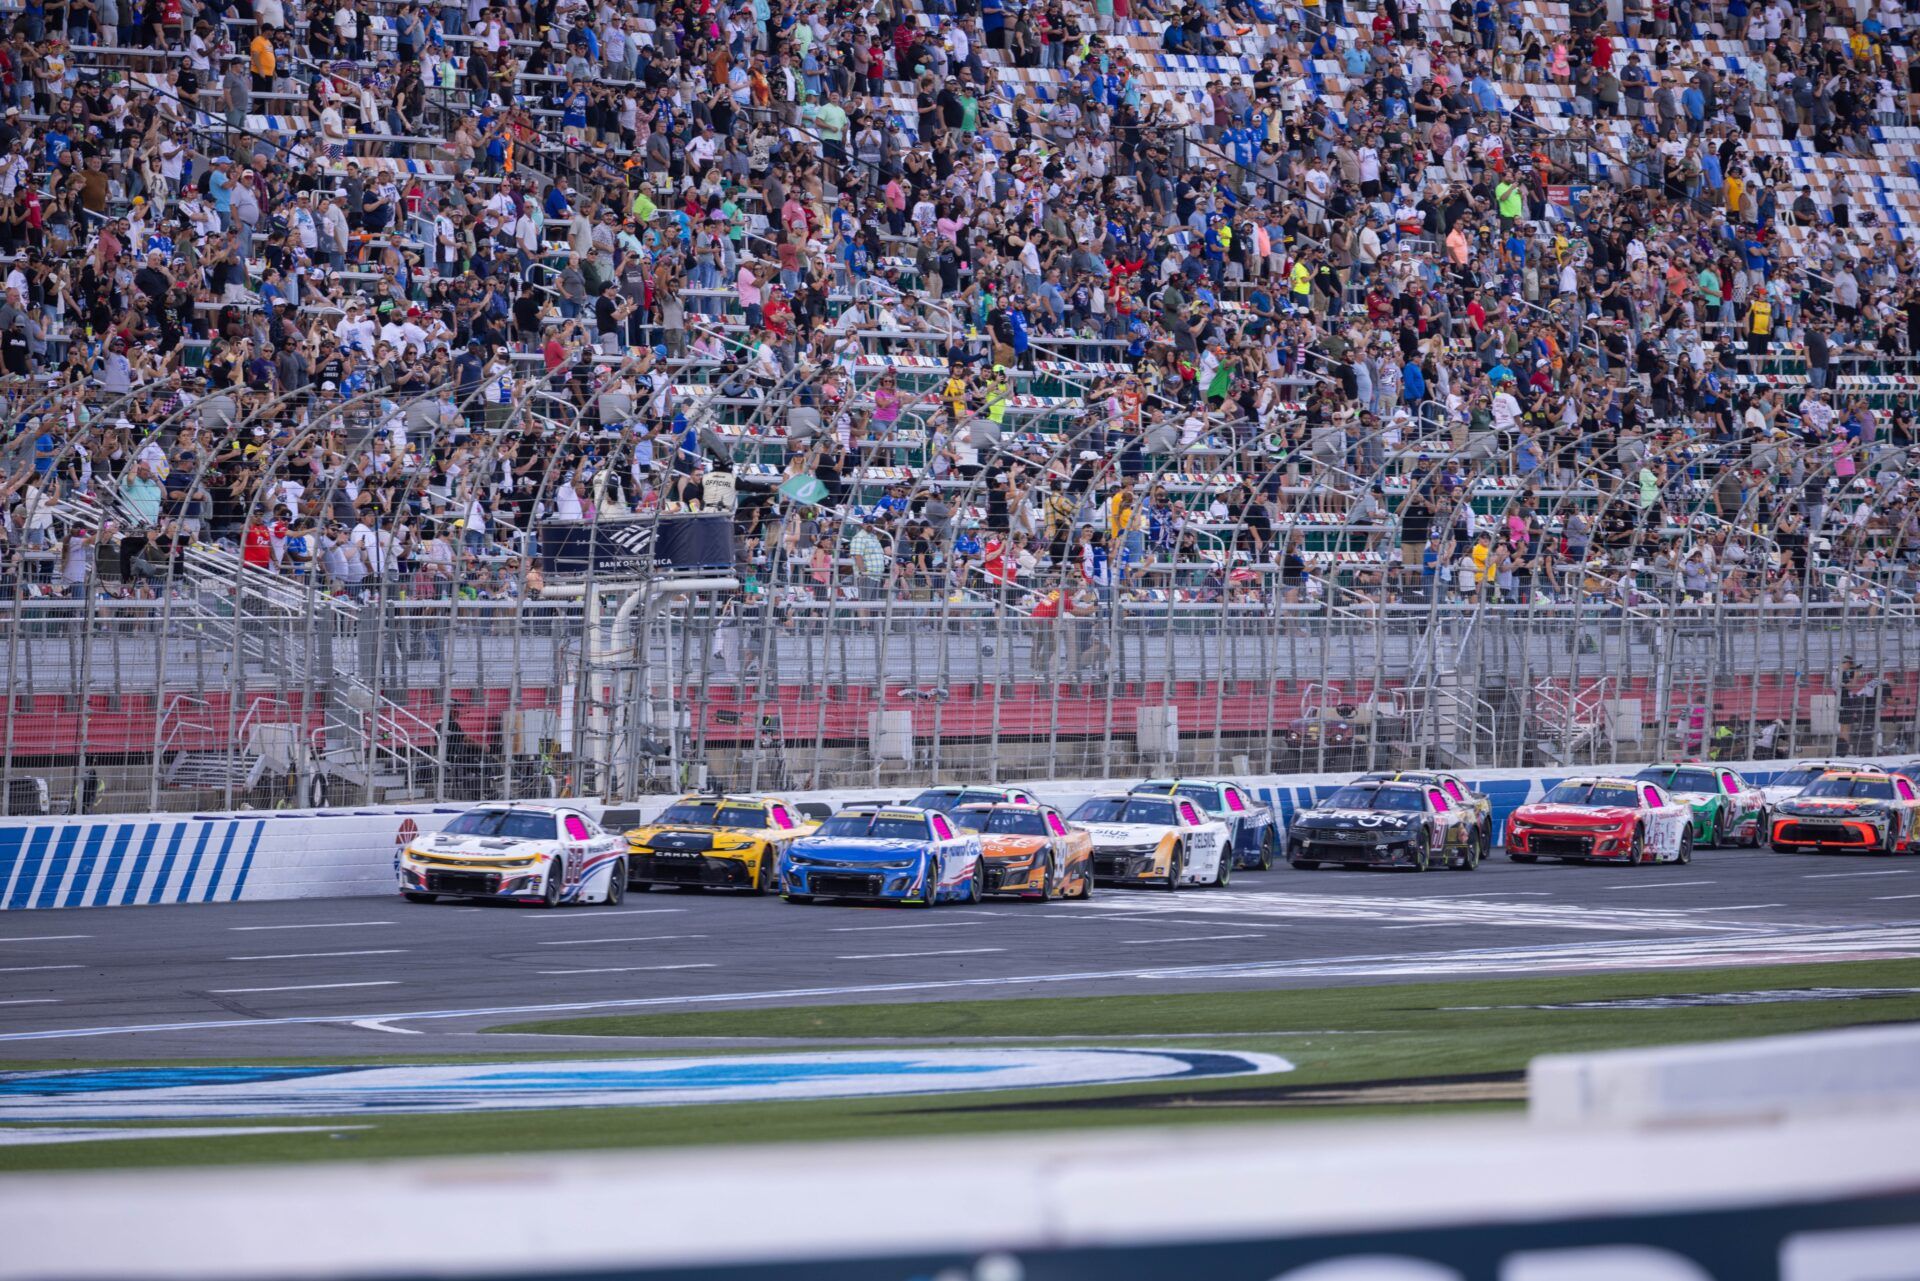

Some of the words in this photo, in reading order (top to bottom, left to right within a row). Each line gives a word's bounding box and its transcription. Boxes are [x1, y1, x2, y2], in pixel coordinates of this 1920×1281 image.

[705, 479, 732, 488] OFFICIAL
[635, 558, 672, 566] AMRICA
[1330, 813, 1408, 828] Kroger
[1194, 832, 1217, 849] CELSIUS
[655, 851, 700, 859] CAMRY
